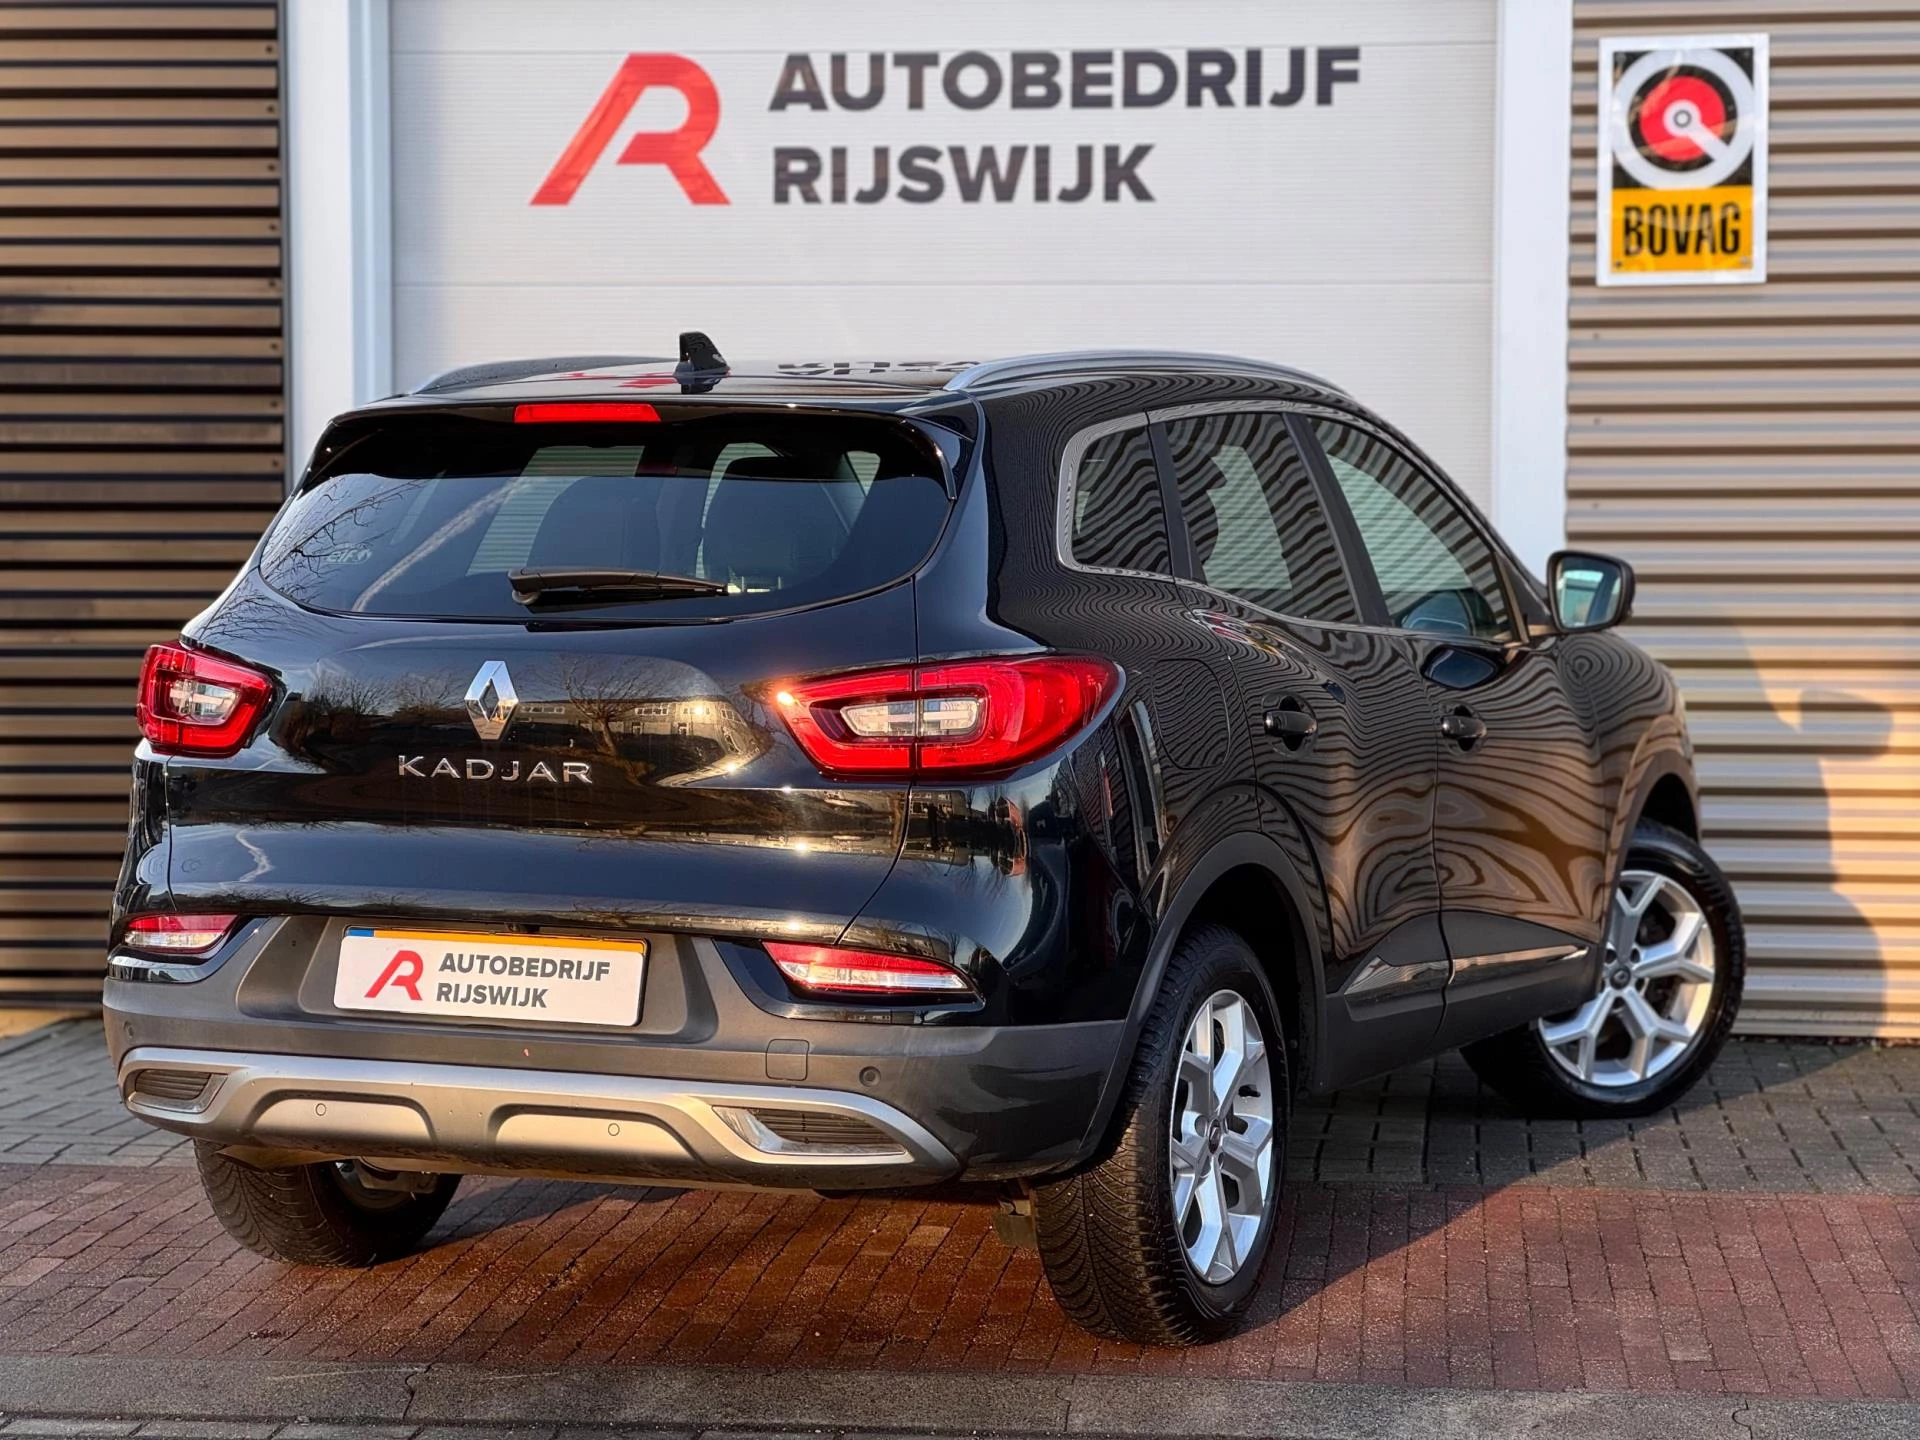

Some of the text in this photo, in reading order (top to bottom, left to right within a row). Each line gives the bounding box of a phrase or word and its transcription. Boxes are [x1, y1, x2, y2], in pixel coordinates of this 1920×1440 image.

[770, 46, 1360, 111] AUTOBEDRIJF
[774, 145, 1154, 204] RIJSWIJK
[1623, 203, 1741, 257] BOVAG
[398, 755, 593, 784] KADJAR
[439, 953, 610, 981] AUTOBEDRIJF
[436, 982, 547, 1008] RIJSWIJK
